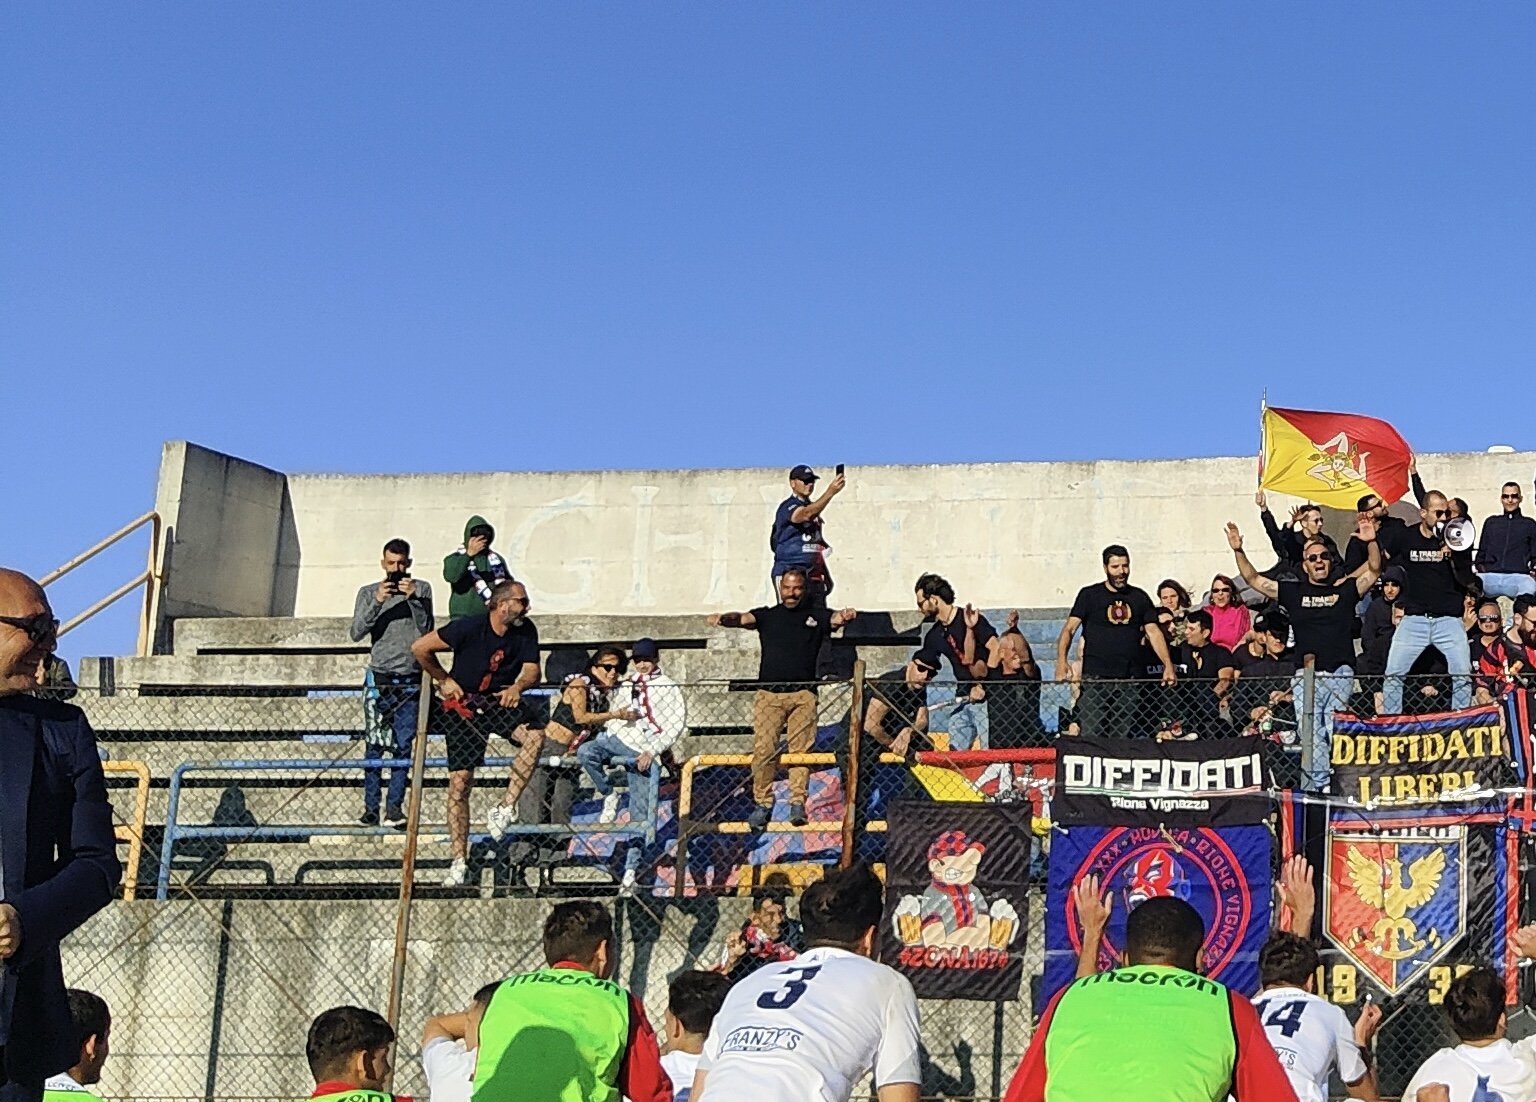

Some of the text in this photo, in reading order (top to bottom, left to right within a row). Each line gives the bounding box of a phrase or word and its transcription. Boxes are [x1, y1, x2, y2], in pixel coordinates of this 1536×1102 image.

[1331, 726, 1502, 765] DIFFIDATI
[1063, 753, 1262, 791] DIFFIDATI
[1358, 771, 1476, 806] LIBERI
[1149, 798, 1210, 813] Vignazza
[1195, 838, 1236, 890] RIONE
[757, 964, 823, 1009] 3
[1081, 970, 1218, 996] macron
[1316, 964, 1357, 1005] 19
